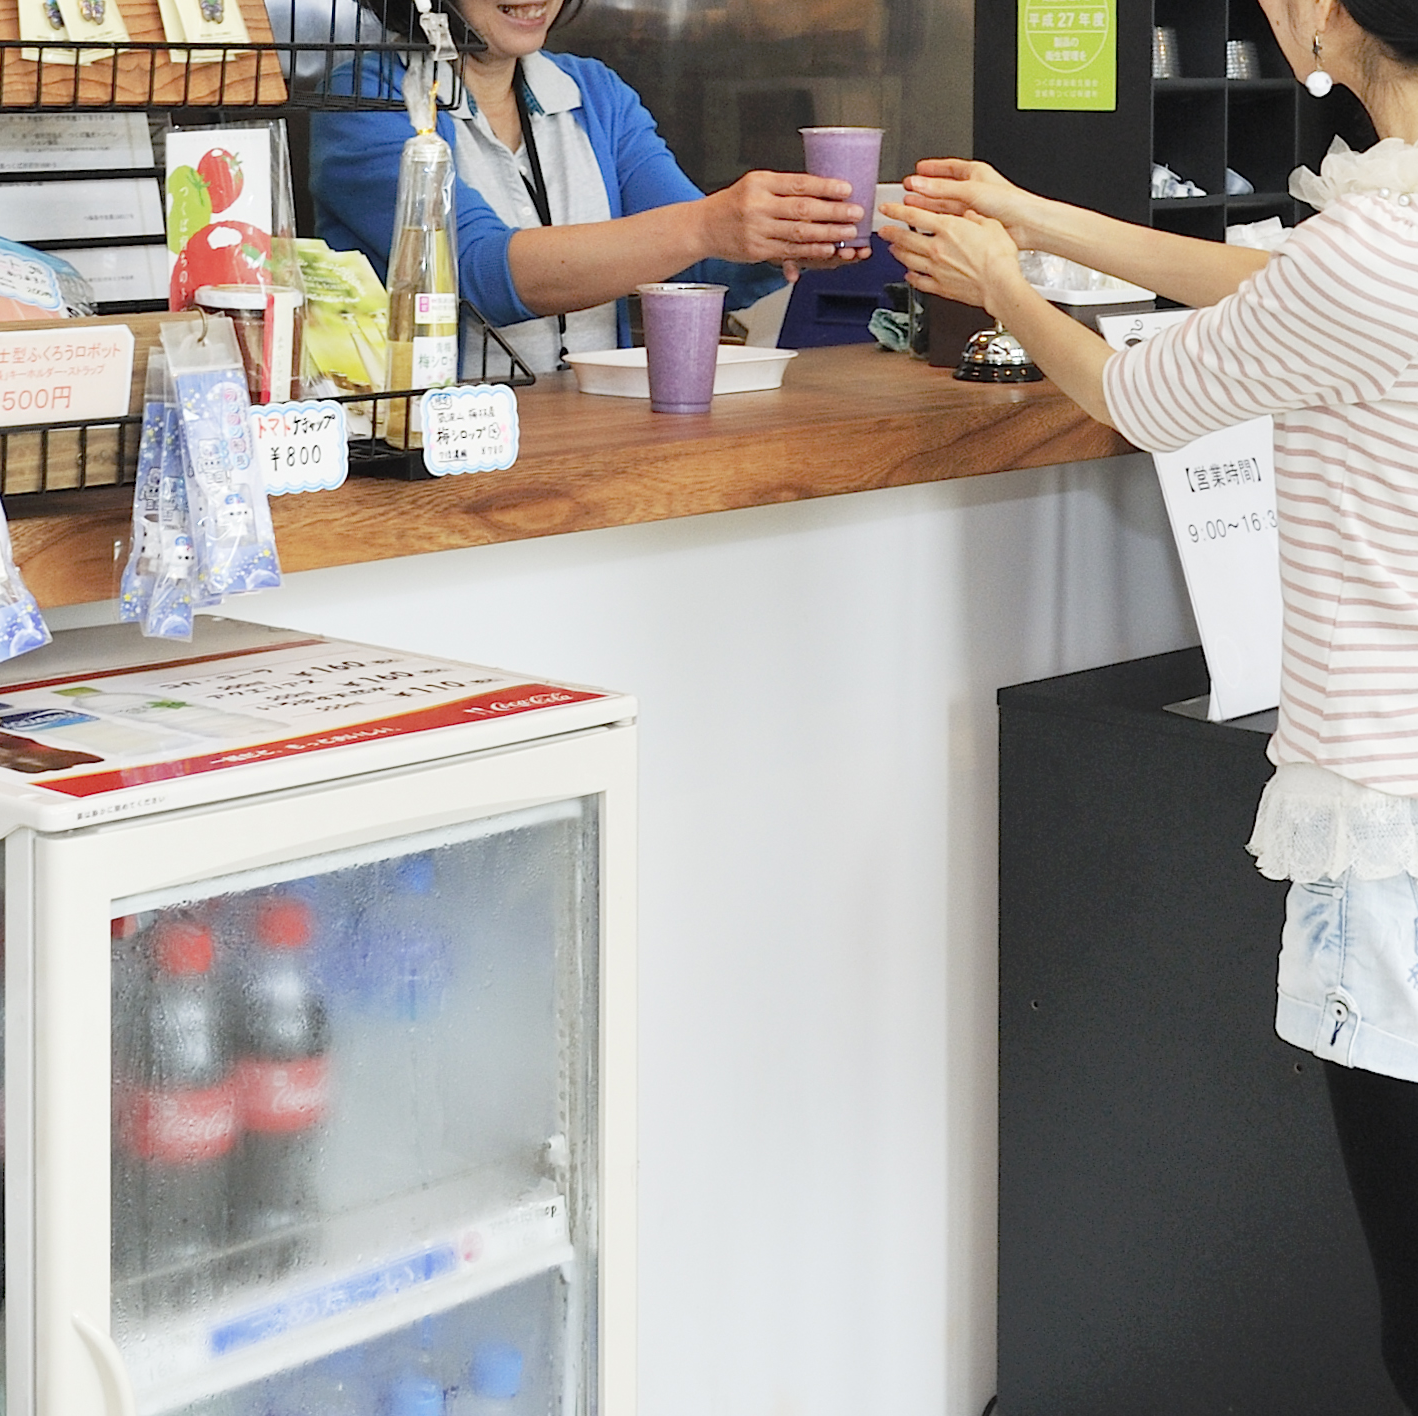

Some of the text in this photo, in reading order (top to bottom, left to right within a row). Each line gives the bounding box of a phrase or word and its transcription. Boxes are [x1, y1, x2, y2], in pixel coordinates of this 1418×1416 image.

[258, 413, 336, 440] トマトケチャップ
[436, 426, 487, 446] 梅シロップ
[269, 443, 322, 472] ¥800
[489, 691, 574, 714] Coca-Cola
